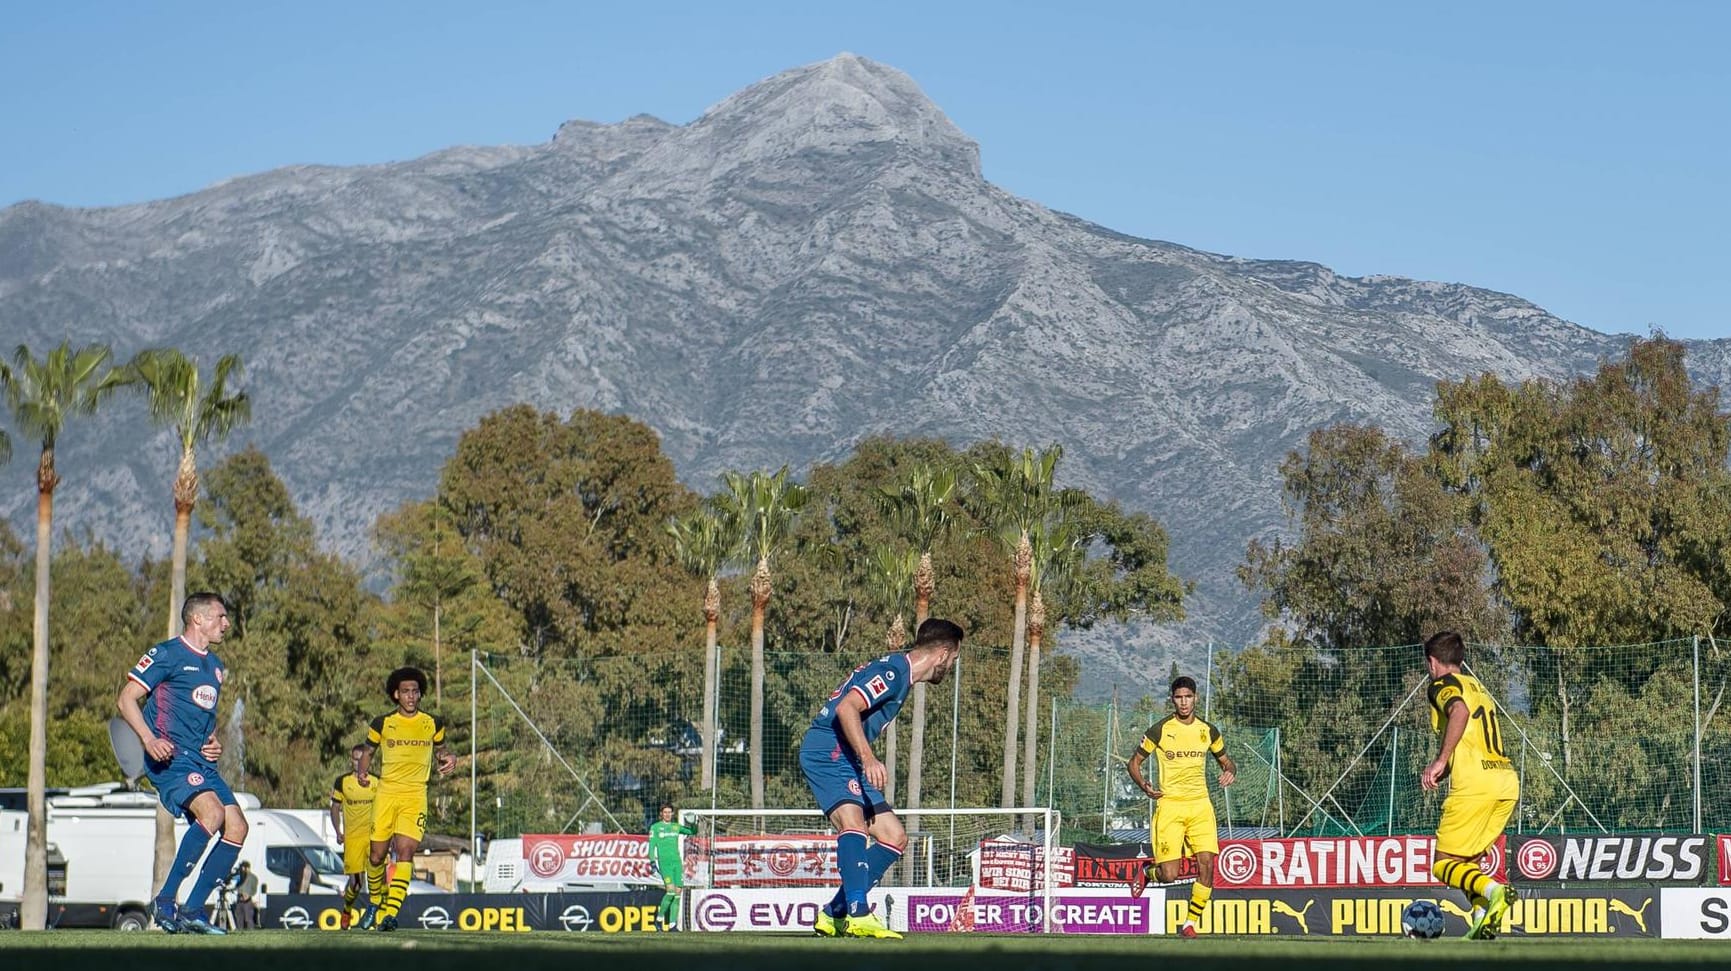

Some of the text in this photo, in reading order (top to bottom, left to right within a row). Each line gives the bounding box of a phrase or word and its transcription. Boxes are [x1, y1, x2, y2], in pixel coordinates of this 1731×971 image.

[571, 840, 650, 857] SHOUTBO
[1262, 839, 1438, 885] RATINGE
[1558, 837, 1705, 880] NEUSS
[458, 907, 533, 931] OPEL
[1008, 903, 1043, 924] TO
[1050, 904, 1142, 925] CREATE
[1167, 899, 1271, 934] PUMA
[1332, 899, 1438, 934] PUM
[1501, 898, 1608, 933] PUMA
